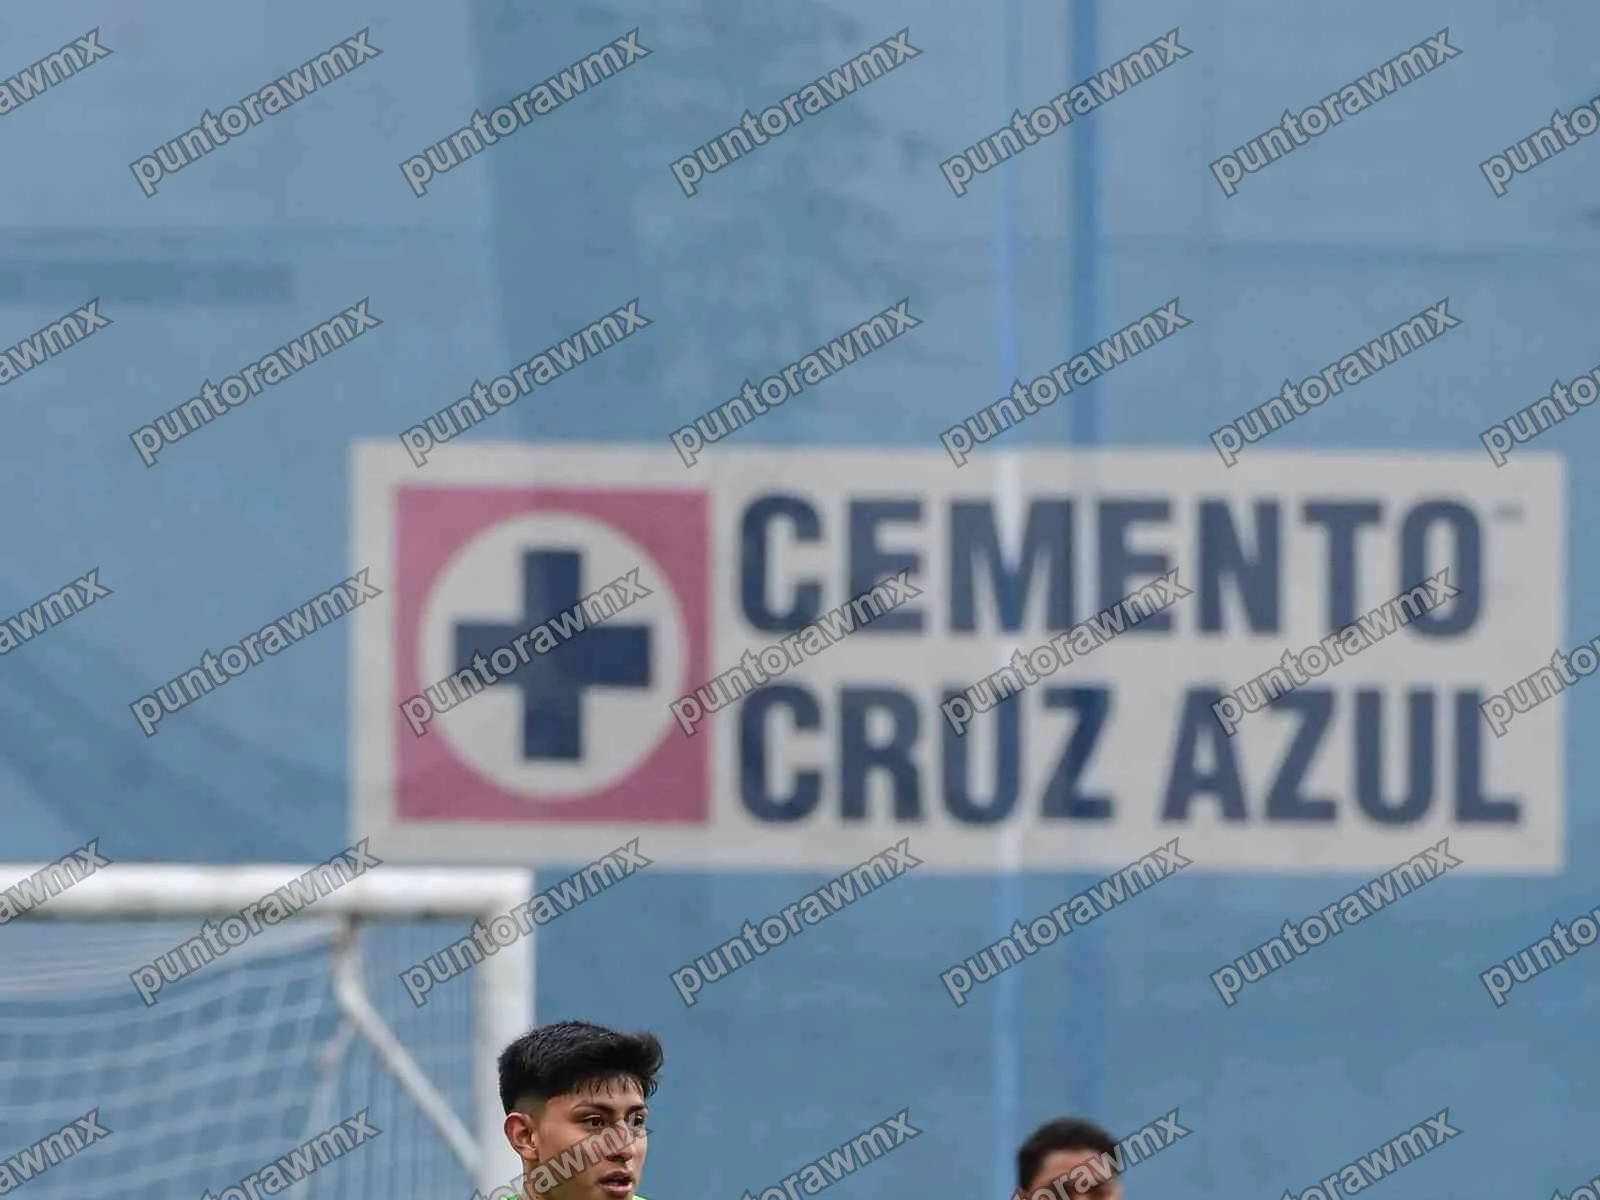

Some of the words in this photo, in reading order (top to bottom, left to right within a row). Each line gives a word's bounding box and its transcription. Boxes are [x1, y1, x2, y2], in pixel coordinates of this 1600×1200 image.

[738, 493, 1484, 640] CEMENTO
[736, 683, 1117, 828] CRUZ
[1161, 685, 1524, 828] AZUL
